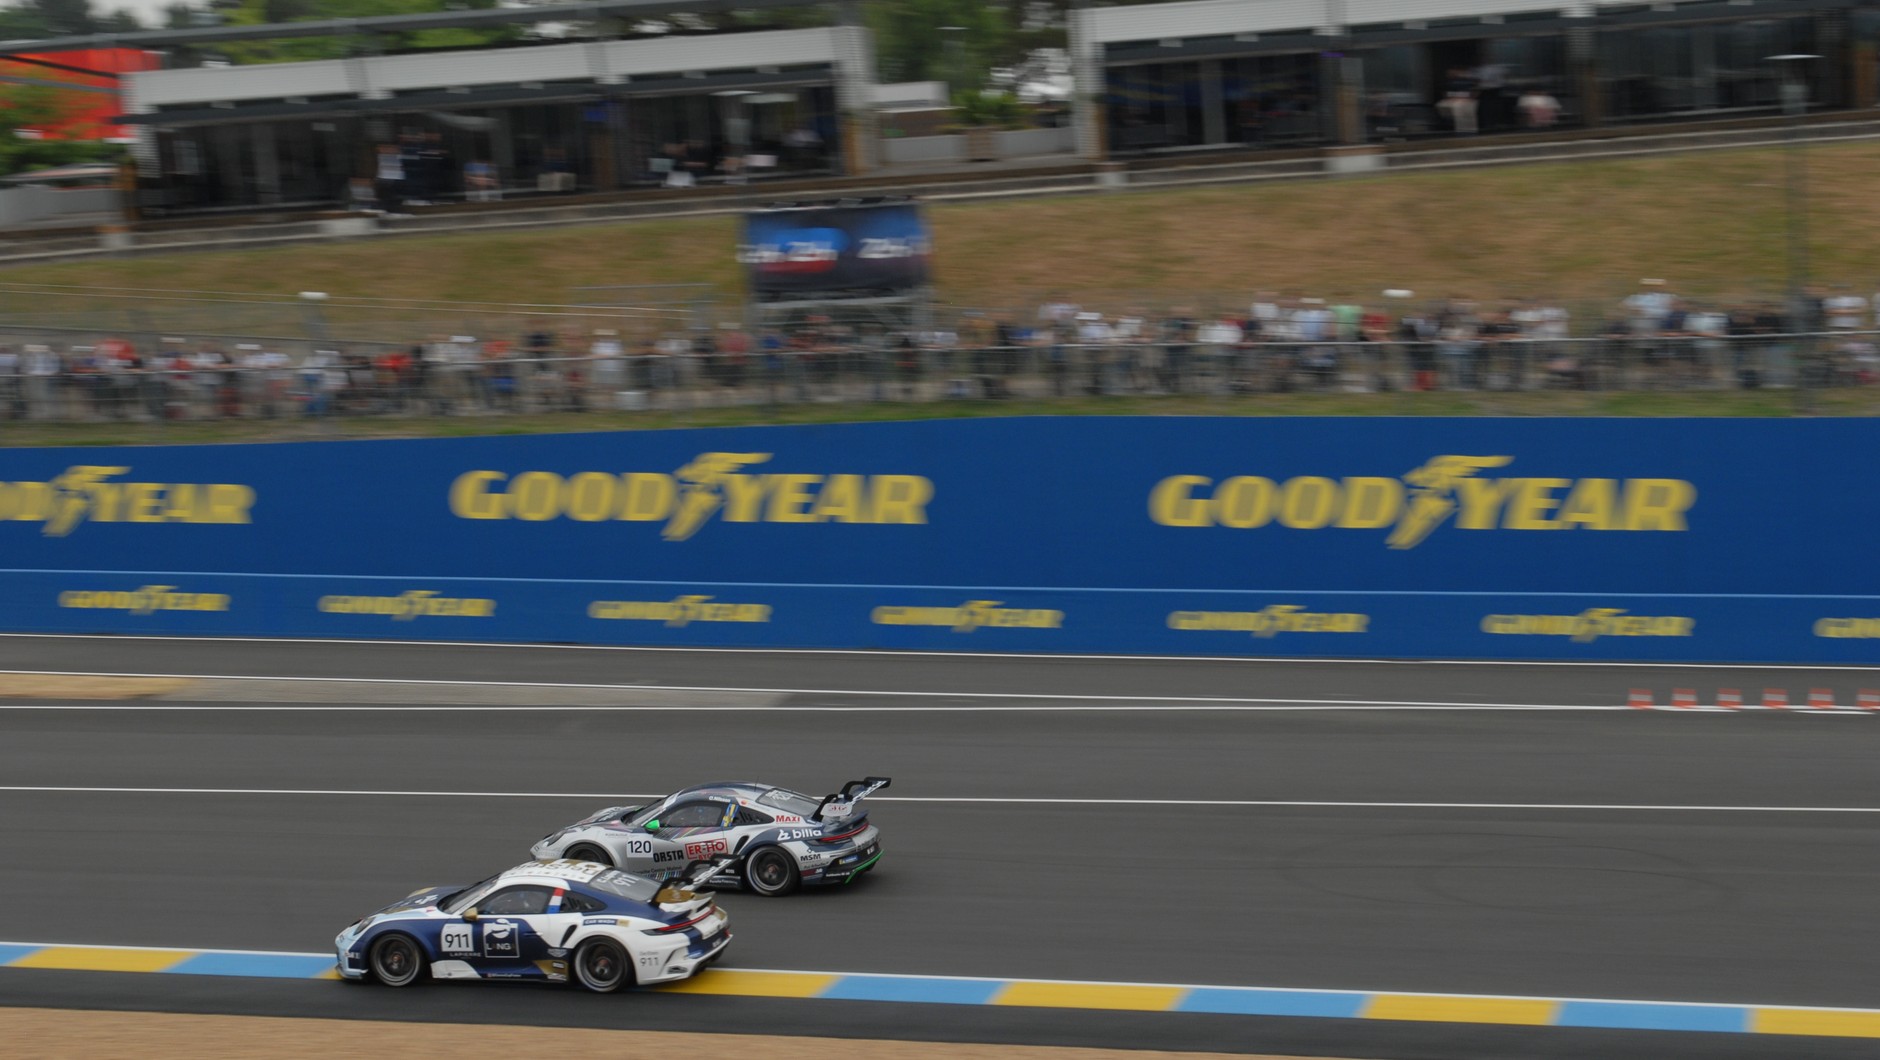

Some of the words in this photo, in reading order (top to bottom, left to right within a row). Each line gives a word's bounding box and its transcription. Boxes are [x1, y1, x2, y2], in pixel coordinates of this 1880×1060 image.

[449, 458, 935, 533] GOODYEAR
[1149, 461, 1697, 542] GOODYEAR
[627, 840, 652, 854] 120
[653, 850, 684, 863] ORSTA
[800, 853, 821, 861] MSM
[444, 933, 470, 948] 911
[640, 957, 659, 967] 911
